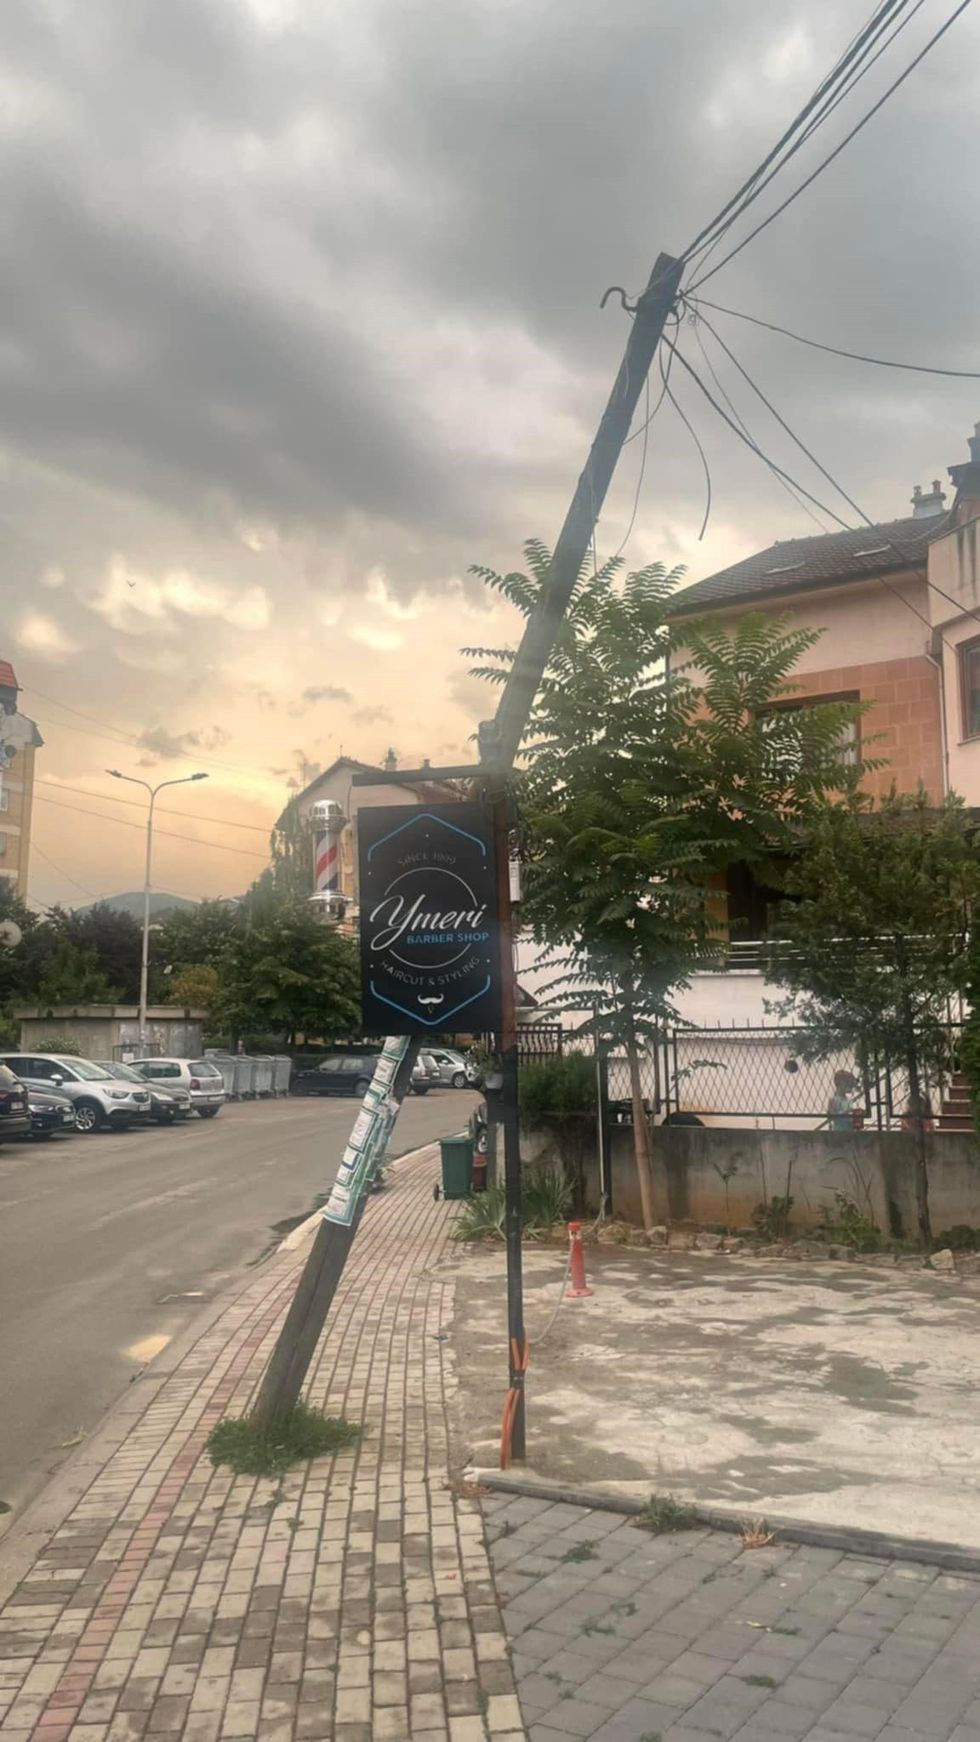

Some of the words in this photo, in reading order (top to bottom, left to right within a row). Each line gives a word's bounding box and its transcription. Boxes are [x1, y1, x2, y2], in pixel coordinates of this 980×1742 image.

[398, 852, 429, 867] SINCE
[369, 893, 488, 950] Ymeri
[406, 933, 454, 945] BARBER
[457, 931, 489, 943] SHOP
[381, 960, 424, 985] HAIRCUT
[427, 977, 436, 985] &
[437, 956, 480, 985] STYLING
